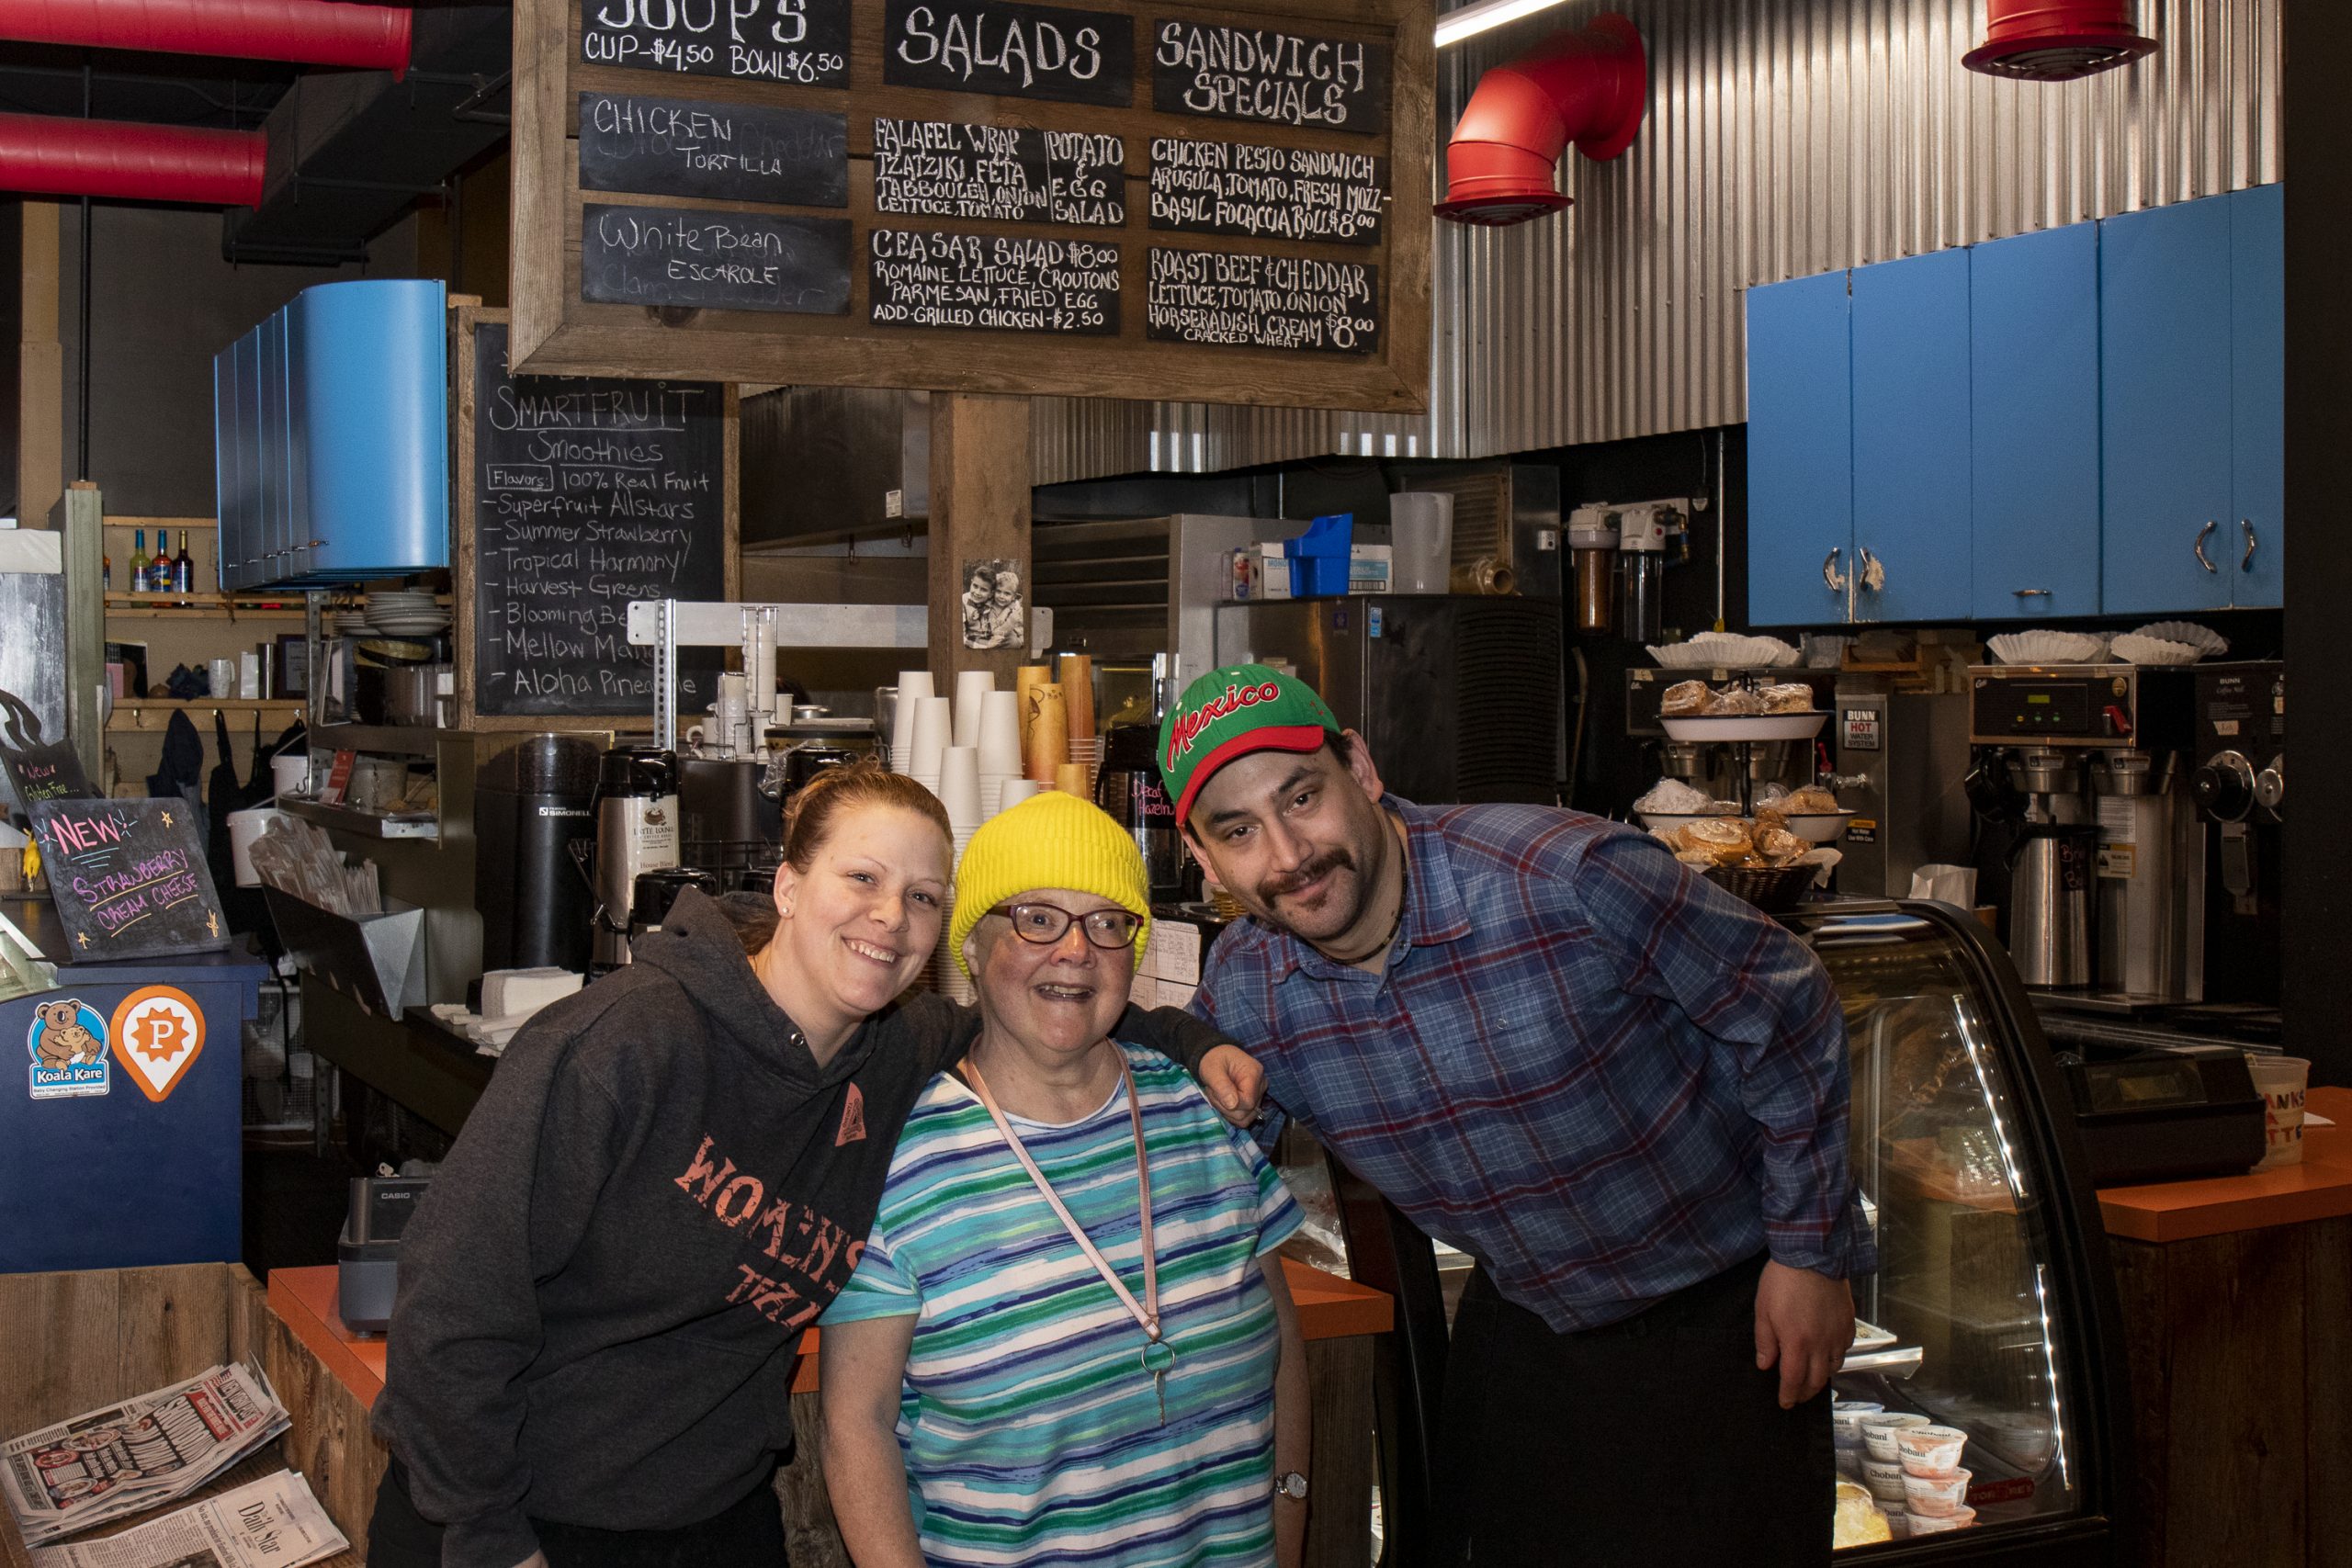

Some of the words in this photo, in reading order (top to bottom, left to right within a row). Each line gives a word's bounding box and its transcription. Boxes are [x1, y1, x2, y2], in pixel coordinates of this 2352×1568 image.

[898, 6, 1101, 88] SALADS
[1157, 23, 1363, 92] SANDWICH
[1183, 73, 1347, 125] SPECIALS
[594, 99, 732, 141] CHICKEN
[875, 118, 962, 159] FALAFEL
[965, 124, 1020, 162] WRAP
[1047, 131, 1124, 167] POTATO
[675, 146, 783, 176] TORTILLA
[977, 160, 1028, 192] FETA
[1152, 139, 1227, 170] CHICKEN
[1236, 143, 1285, 173] PESTO
[1290, 151, 1374, 186] SANDWICH
[996, 186, 1047, 209] ONION
[1052, 178, 1107, 198] EGG
[1295, 179, 1341, 210] FRESH
[1347, 185, 1382, 216] MOZZ
[958, 200, 1024, 220] TOMATO
[1055, 199, 1124, 225] SALAD
[1152, 192, 1212, 225] BASIL
[1216, 201, 1293, 238] FOCACCIA
[1292, 205, 1330, 239] ROLL
[599, 214, 703, 252] White
[705, 225, 783, 254] Bean
[873, 230, 984, 269] CEASAR
[994, 238, 1064, 269] SALAD
[1066, 241, 1118, 269] $8.00
[668, 259, 779, 285] ESCAROLE
[874, 260, 956, 287] ROMAINE
[1038, 268, 1120, 291] CROUTONS
[1151, 248, 1215, 284] ROAST
[1215, 254, 1262, 286] BEEF
[1274, 259, 1370, 304] CHEDDAR
[998, 288, 1057, 308] FRIED
[1065, 292, 1098, 310] EGG
[1286, 291, 1347, 314] ONION
[1148, 304, 1259, 337] HORSERADISH
[1266, 316, 1322, 346] CREAM
[1184, 329, 1248, 345] CRACKED
[1254, 332, 1301, 348] WHEAT
[528, 430, 663, 461] Smoothies
[562, 469, 609, 490] 100%
[615, 471, 657, 490] Real
[664, 470, 709, 492] Fruit
[505, 519, 581, 542] Summer
[586, 519, 692, 567] Strawberry
[501, 547, 580, 578] Tropical
[589, 547, 680, 583] Harmony
[506, 577, 582, 597] Harvest
[588, 574, 662, 598] Greens
[506, 602, 598, 636] Blooming
[506, 627, 584, 660] Mellow
[514, 668, 593, 695] Aloha
[600, 670, 696, 697] Pineale
[1167, 682, 1280, 773] Mexico
[1848, 710, 1875, 721] BUNN
[1850, 722, 1871, 732] HOT
[27, 760, 51, 780] New
[1131, 779, 1163, 797] Decaf
[51, 813, 121, 855] NEW
[73, 848, 189, 904] STRAWBERRY
[96, 896, 149, 931] CREAM
[152, 874, 198, 905] CHEESE
[150, 1020, 174, 1049] P
[37, 1069, 72, 1084] Koala
[74, 1068, 103, 1081] Kare
[153, 1395, 219, 1465] SHOWDOWN
[1870, 1470, 1902, 1480] Choban
[238, 1501, 275, 1534] Daily
[254, 1529, 283, 1555] Star
